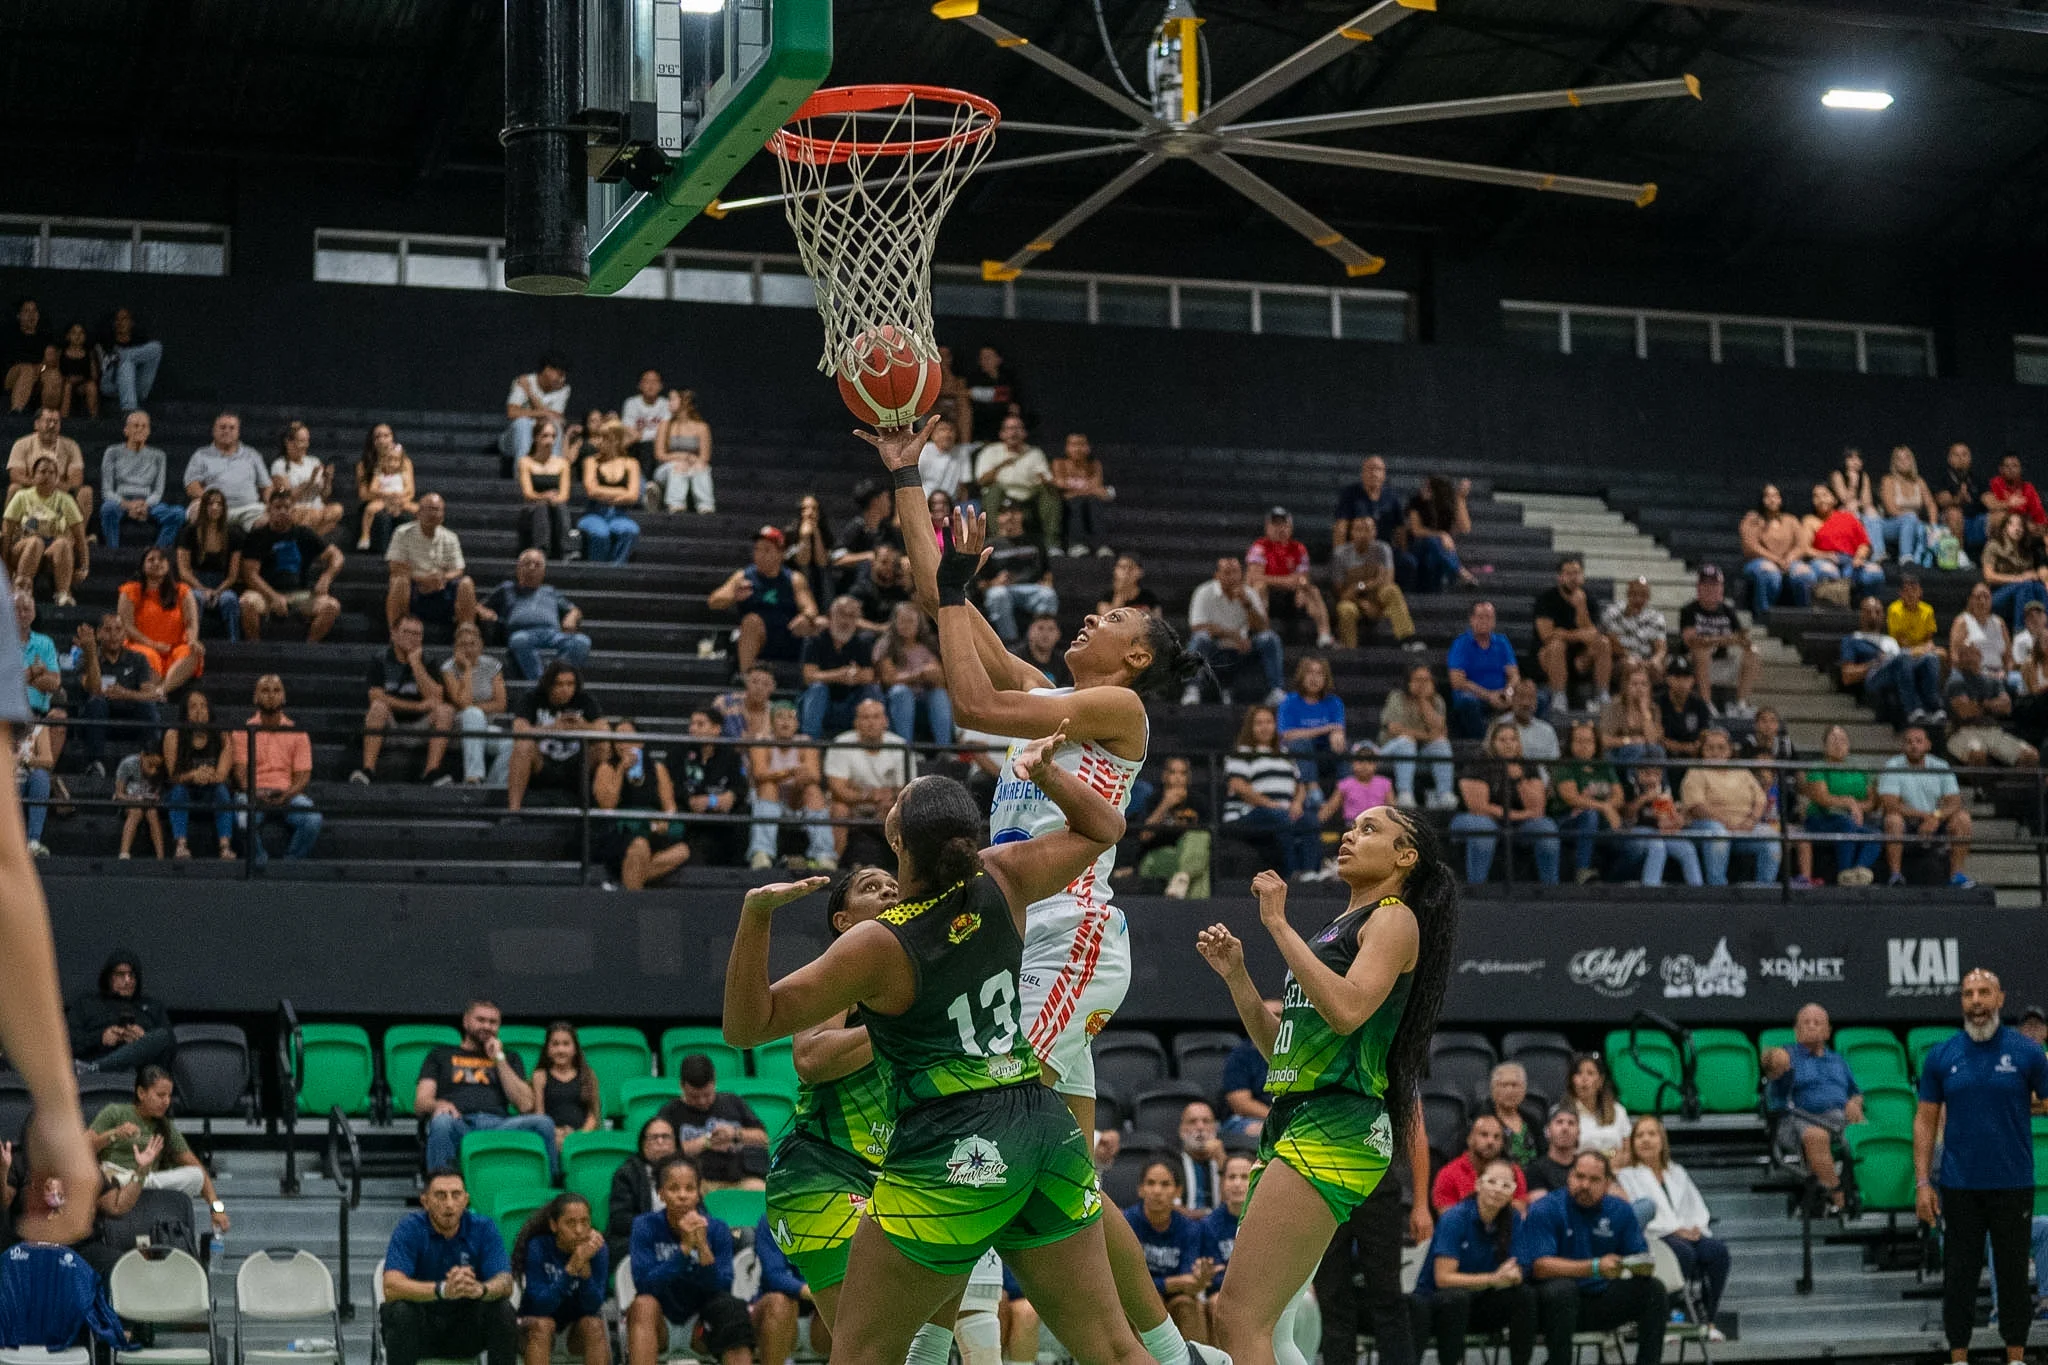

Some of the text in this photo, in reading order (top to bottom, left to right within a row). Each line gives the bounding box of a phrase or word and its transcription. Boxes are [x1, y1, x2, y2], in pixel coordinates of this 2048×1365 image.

[659, 136, 676, 148] 10'
[1887, 938, 1960, 986] KAI
[947, 968, 1018, 1058] 13
